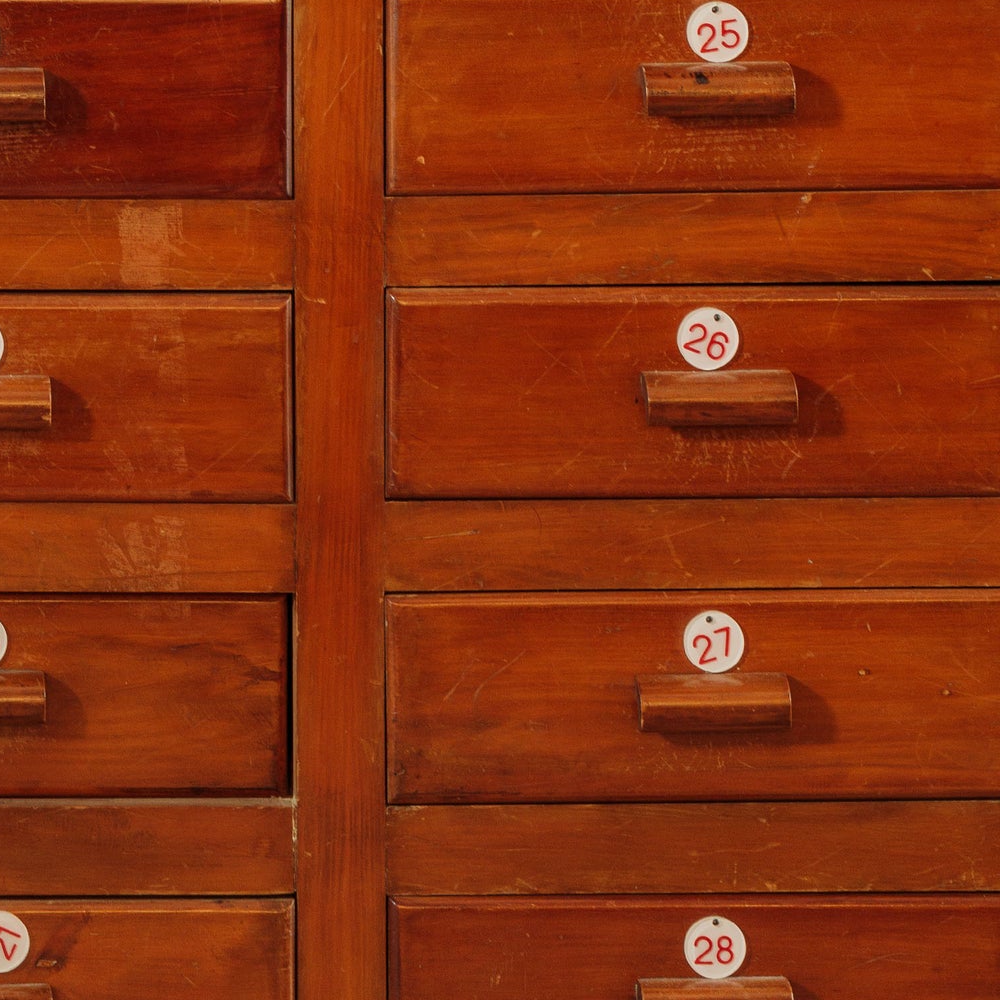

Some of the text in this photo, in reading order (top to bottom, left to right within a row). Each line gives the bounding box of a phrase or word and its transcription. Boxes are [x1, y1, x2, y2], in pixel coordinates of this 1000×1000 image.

[696, 18, 741, 54] 25
[683, 322, 730, 361] 26
[692, 626, 731, 665] 27
[693, 935, 735, 966] 28
